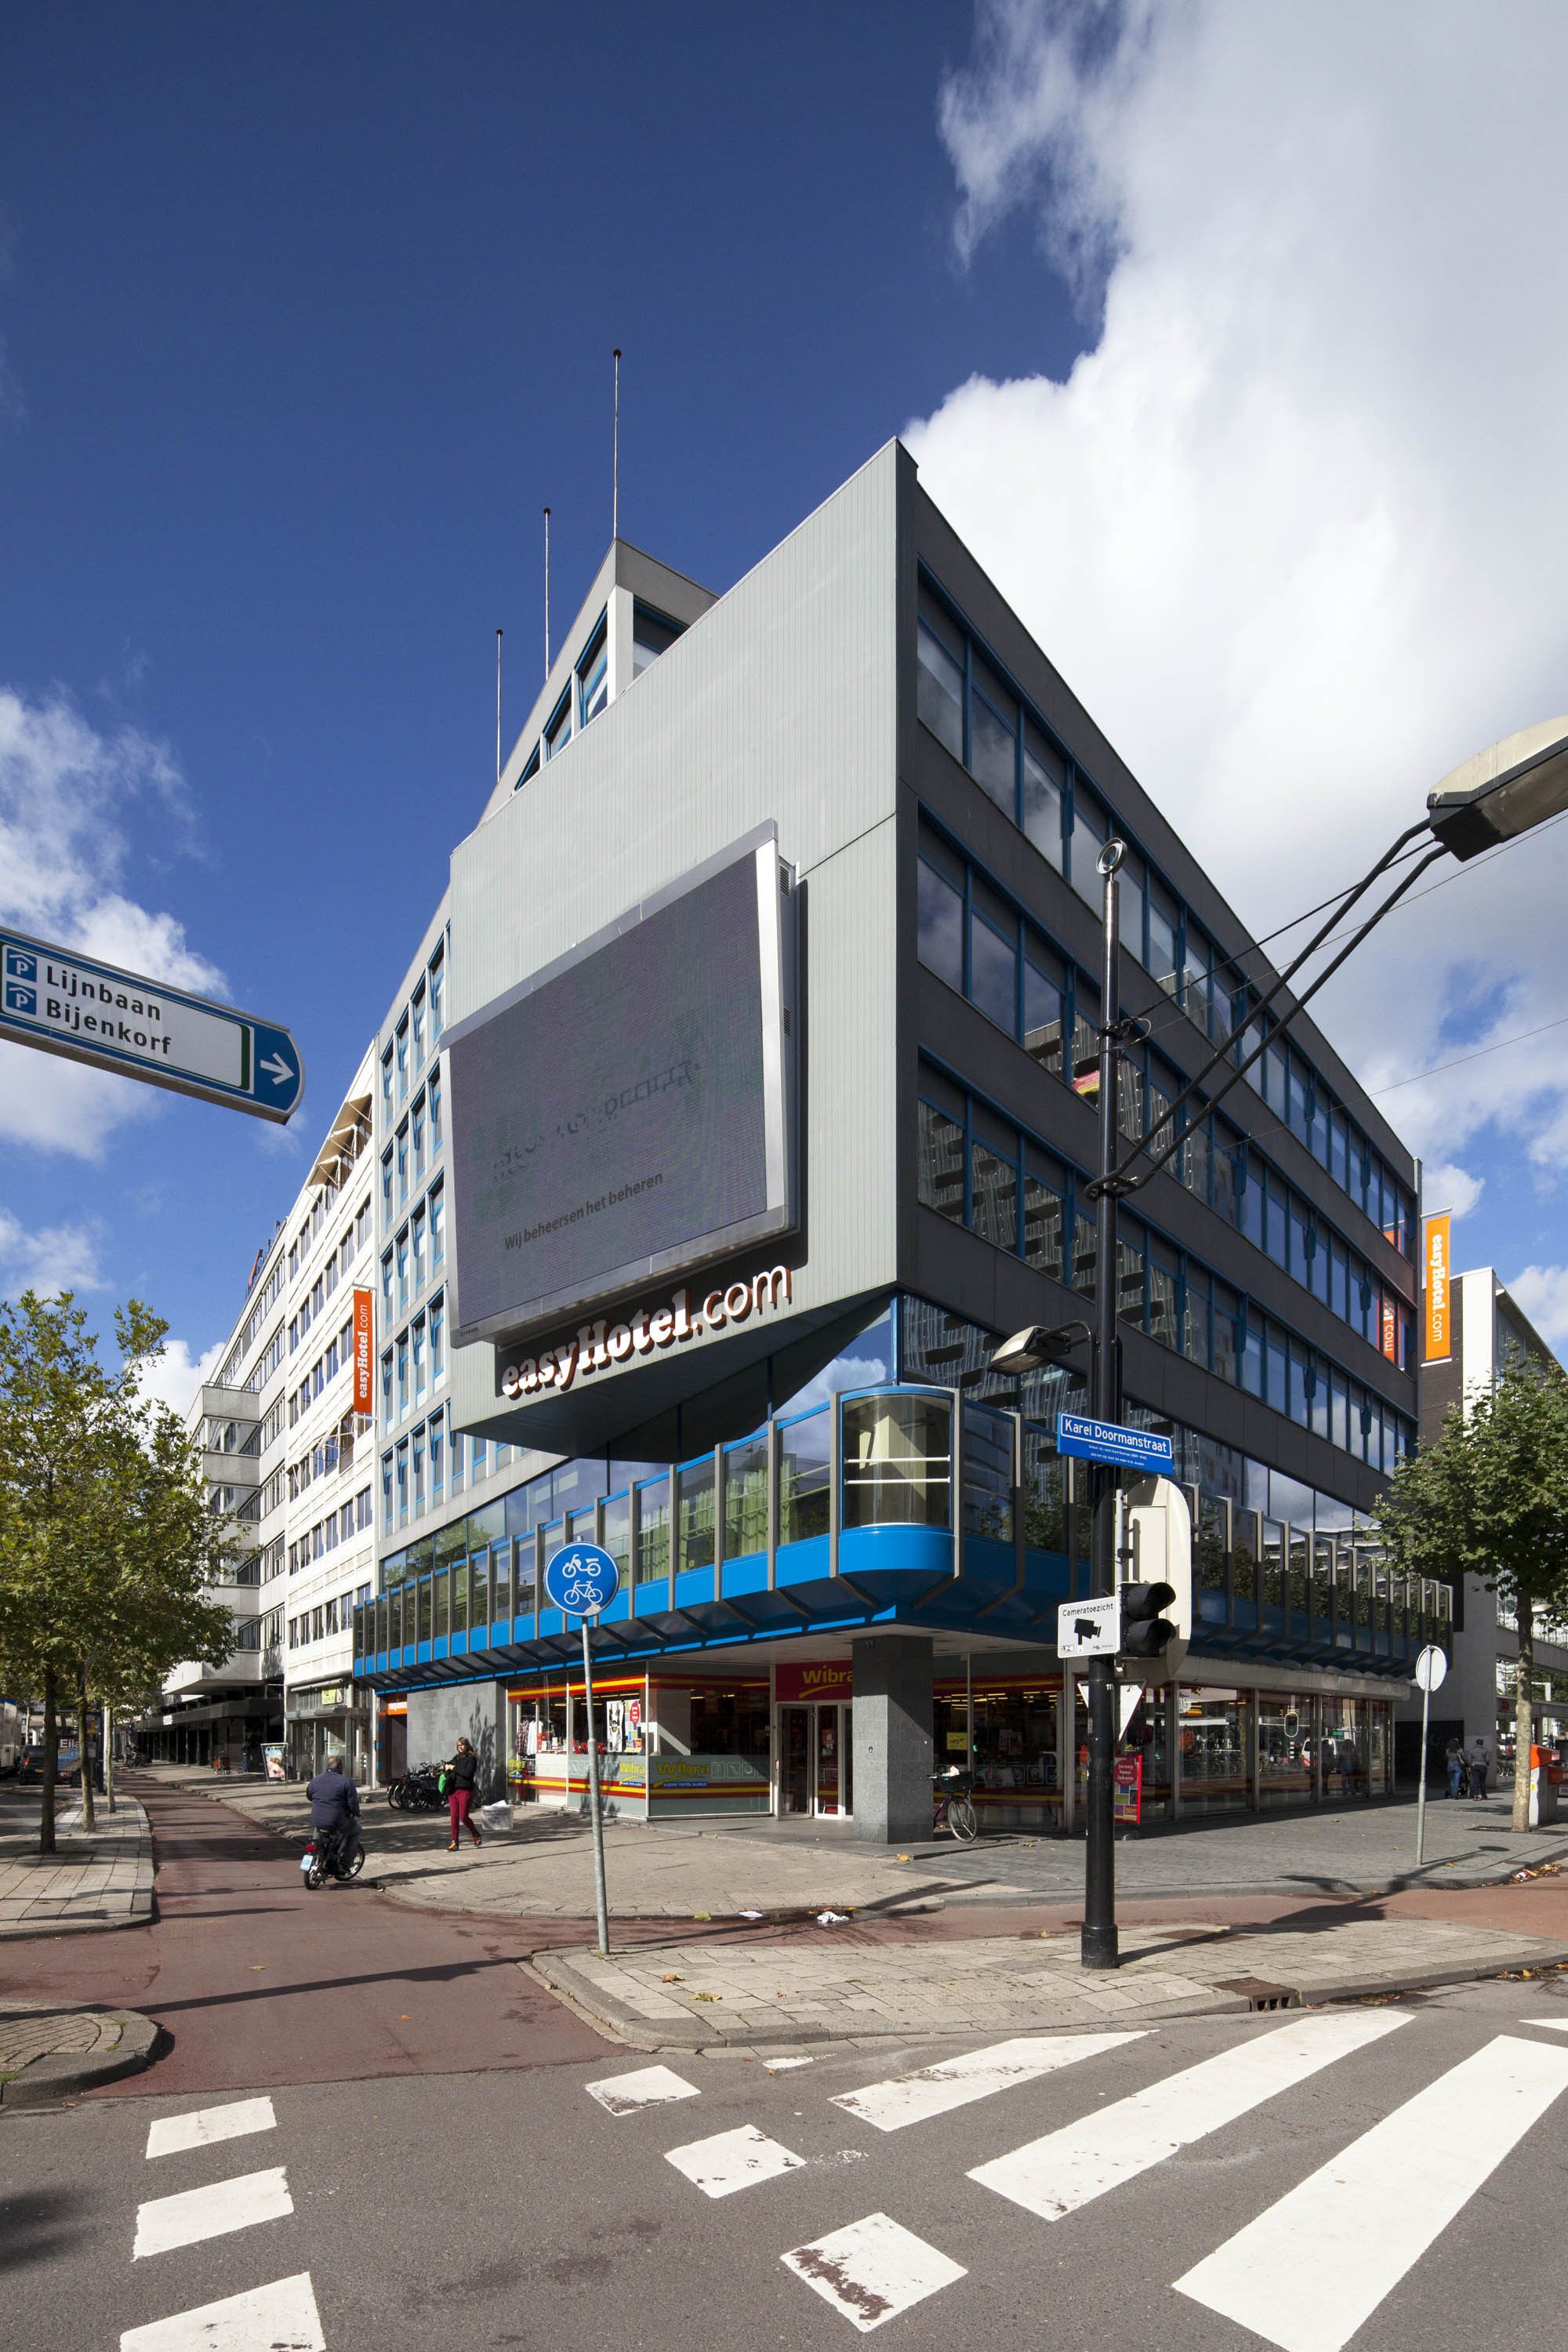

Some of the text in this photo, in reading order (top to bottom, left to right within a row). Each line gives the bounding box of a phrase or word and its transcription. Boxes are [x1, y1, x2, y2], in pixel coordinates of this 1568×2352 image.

[16, 960, 29, 975] P
[16, 992, 28, 1009] P
[47, 965, 161, 1021] Lijnbaan
[46, 998, 171, 1054] Bijenkorf
[504, 1171, 663, 1250] Wij beheersen het beheren
[1431, 1234, 1446, 1341] easyHotel.com
[502, 1265, 791, 1399] easyHotel.com
[358, 1305, 369, 1399] easyHotel.com
[1065, 1418, 1092, 1437] Karel
[1094, 1426, 1167, 1453] Doormanstraat
[1062, 1602, 1114, 1617] Cameratoezicht
[802, 1664, 853, 1684] Wibra
[619, 1761, 645, 1775] Wibra
[655, 1759, 711, 1776] Wibra
